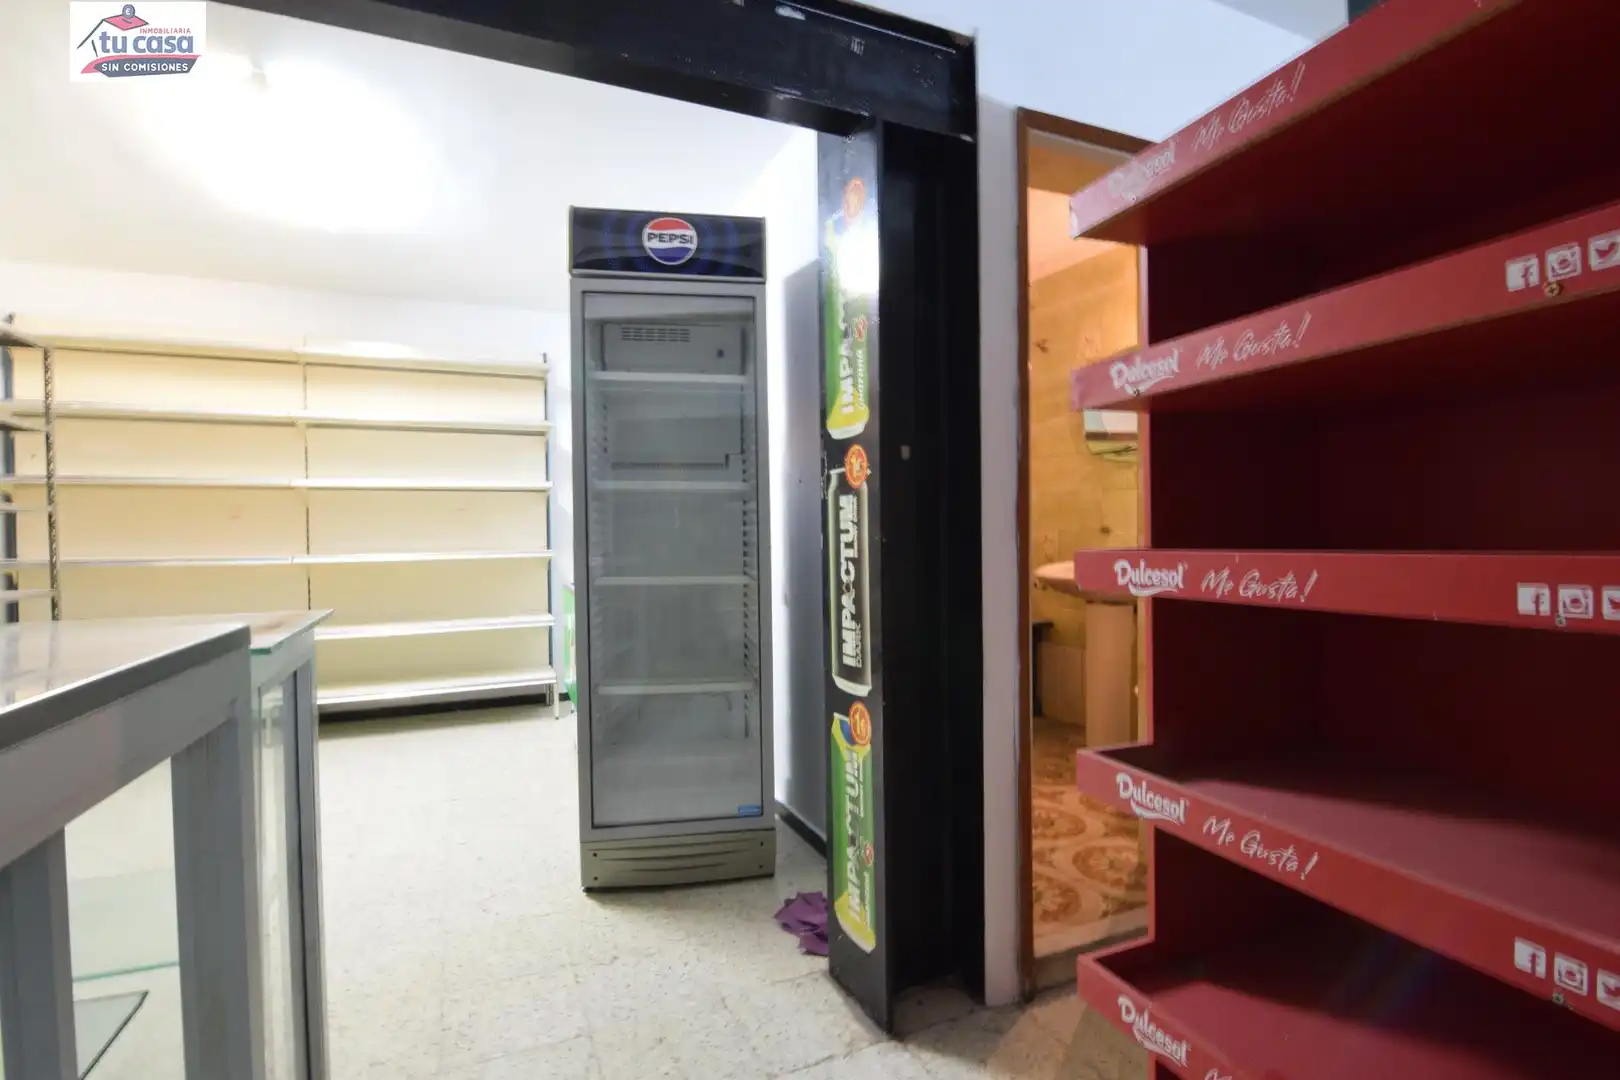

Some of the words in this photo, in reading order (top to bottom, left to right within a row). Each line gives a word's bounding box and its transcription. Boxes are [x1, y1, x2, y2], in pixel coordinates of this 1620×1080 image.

[647, 232, 695, 244] PEPSI
[839, 494, 857, 667] IMPACTUM
[1113, 559, 1185, 590] Dulcesol
[1201, 566, 1234, 598] Me
[1239, 569, 1318, 603] Gusta!
[1116, 772, 1187, 824] Dulcesol
[1203, 815, 1235, 846] Me
[1241, 830, 1318, 880] Gusta!
[1118, 994, 1188, 1067] Dulcesol
